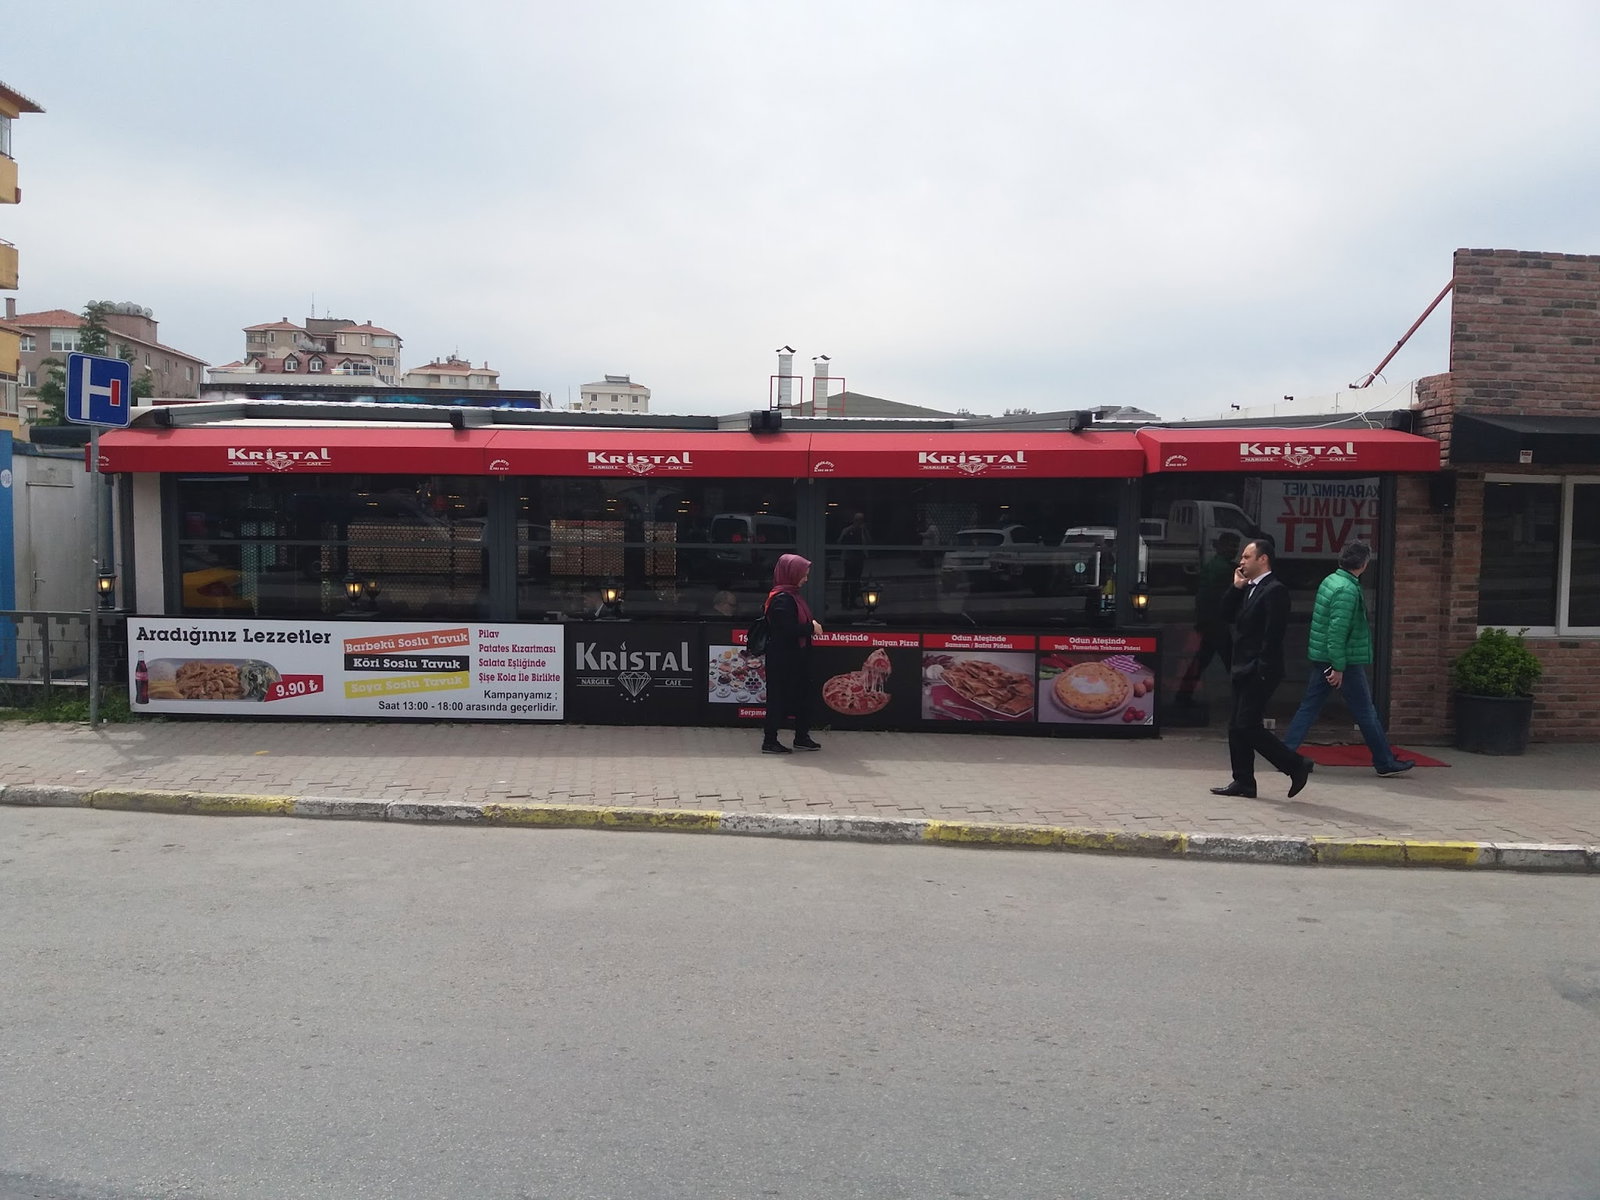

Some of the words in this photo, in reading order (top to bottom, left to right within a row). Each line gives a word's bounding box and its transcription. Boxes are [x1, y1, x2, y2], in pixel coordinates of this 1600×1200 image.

[243, 628, 332, 644] Lezzetler
[478, 629, 500, 638] Pilav
[951, 634, 973, 642] Odun
[345, 641, 396, 653] Barbekü
[398, 637, 429, 648] Soslu
[432, 633, 468, 645] Tavuk
[478, 644, 510, 653] Patates
[899, 639, 919, 647] Pizza
[353, 657, 380, 668] Köri
[383, 659, 417, 669] Soslu
[421, 660, 461, 669] Tavuk
[478, 658, 506, 667] Salata
[478, 672, 496, 683] Şişe
[497, 673, 517, 682] Kola
[531, 673, 561, 682] Birlikte
[276, 681, 305, 697] 9.90
[351, 683, 382, 693] Soya
[385, 680, 420, 690] Soslu
[423, 676, 463, 687] Tavuk
[378, 701, 400, 710] Saat
[402, 701, 428, 711] 13:00
[437, 702, 463, 711] 18:00
[465, 702, 508, 712] arasında
[510, 703, 558, 714] geçerlidir.
